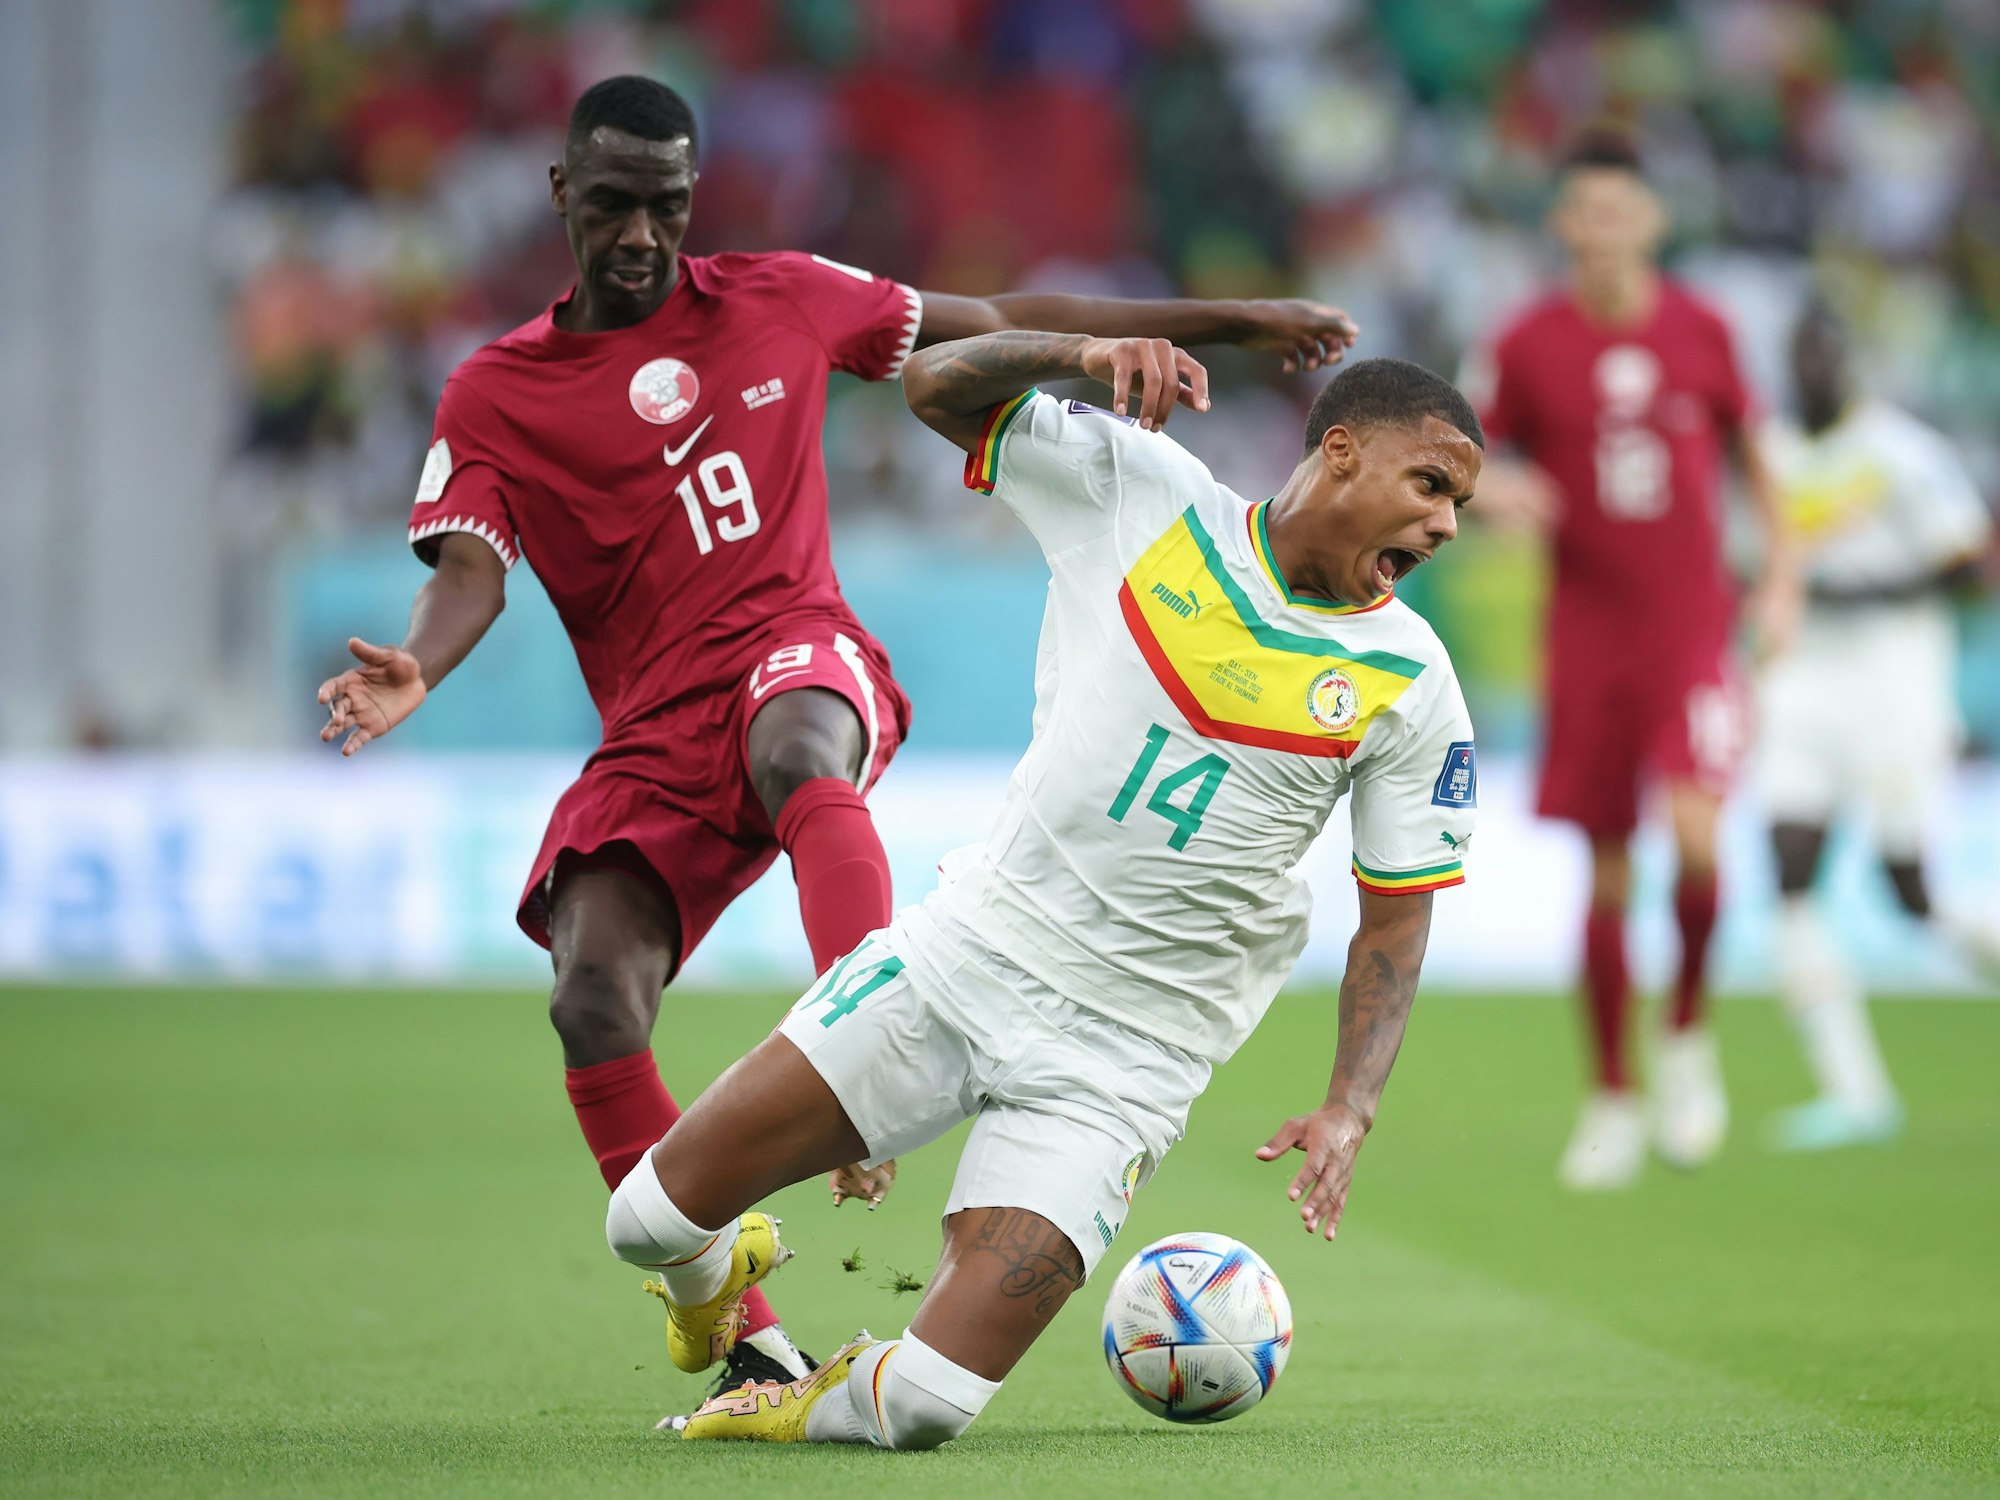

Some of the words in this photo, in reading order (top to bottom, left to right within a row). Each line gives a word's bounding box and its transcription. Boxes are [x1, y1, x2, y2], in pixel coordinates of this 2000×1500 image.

[674, 450, 761, 556] 19
[1151, 582, 1193, 619] PUMA
[1215, 663, 1224, 673] 25
[1244, 669, 1258, 681] SEN
[1107, 722, 1231, 853] 14
[800, 938, 906, 1028] 14
[1094, 1211, 1113, 1249] PUMA
